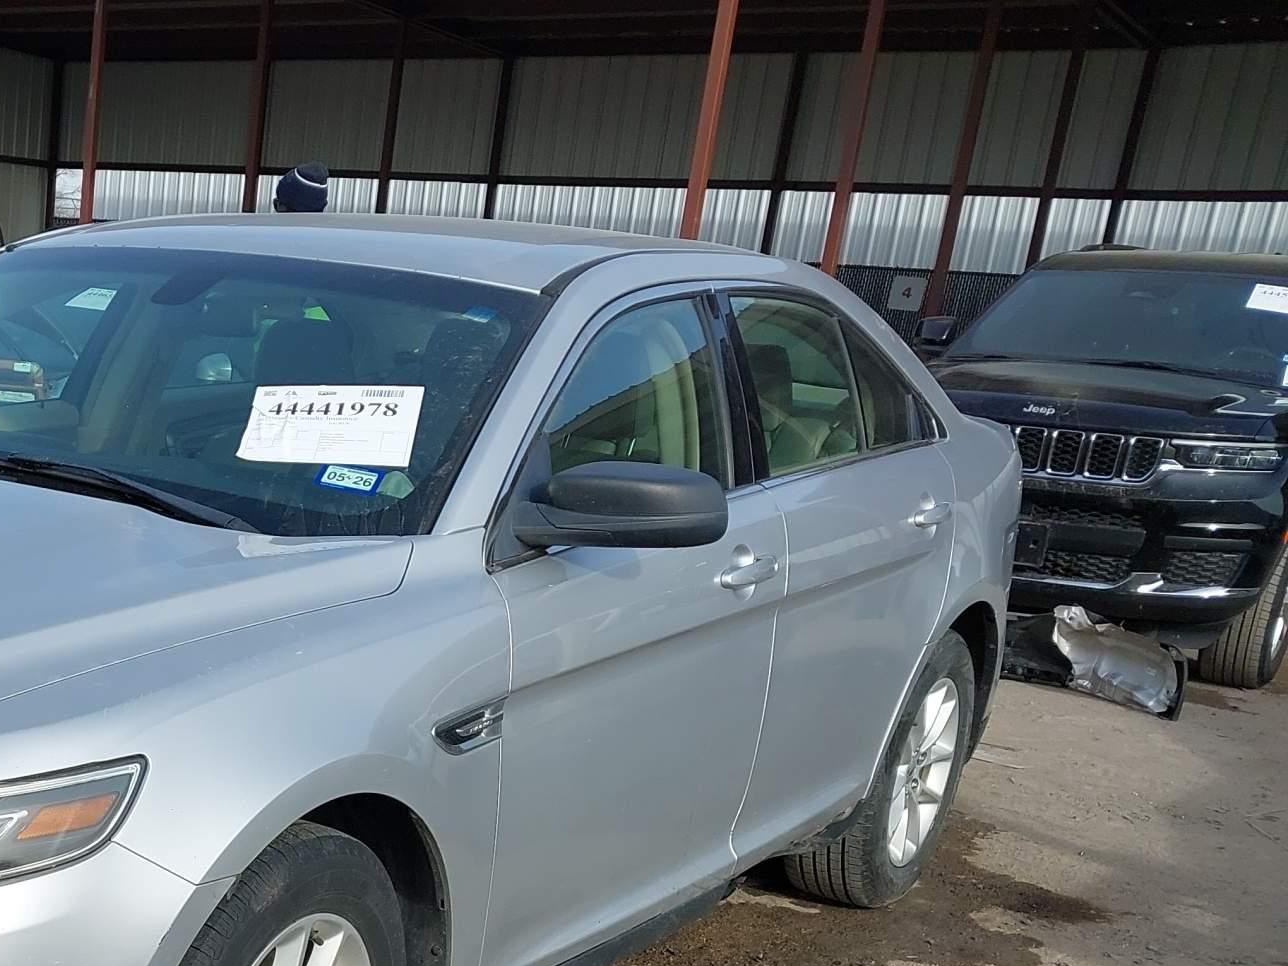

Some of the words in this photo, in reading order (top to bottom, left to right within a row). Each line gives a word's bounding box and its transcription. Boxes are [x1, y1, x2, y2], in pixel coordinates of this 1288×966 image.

[902, 287, 912, 298] 4
[268, 402, 399, 417] 44441978
[1023, 404, 1056, 416] Jeep
[327, 471, 347, 482] 05
[352, 475, 374, 487] 26
